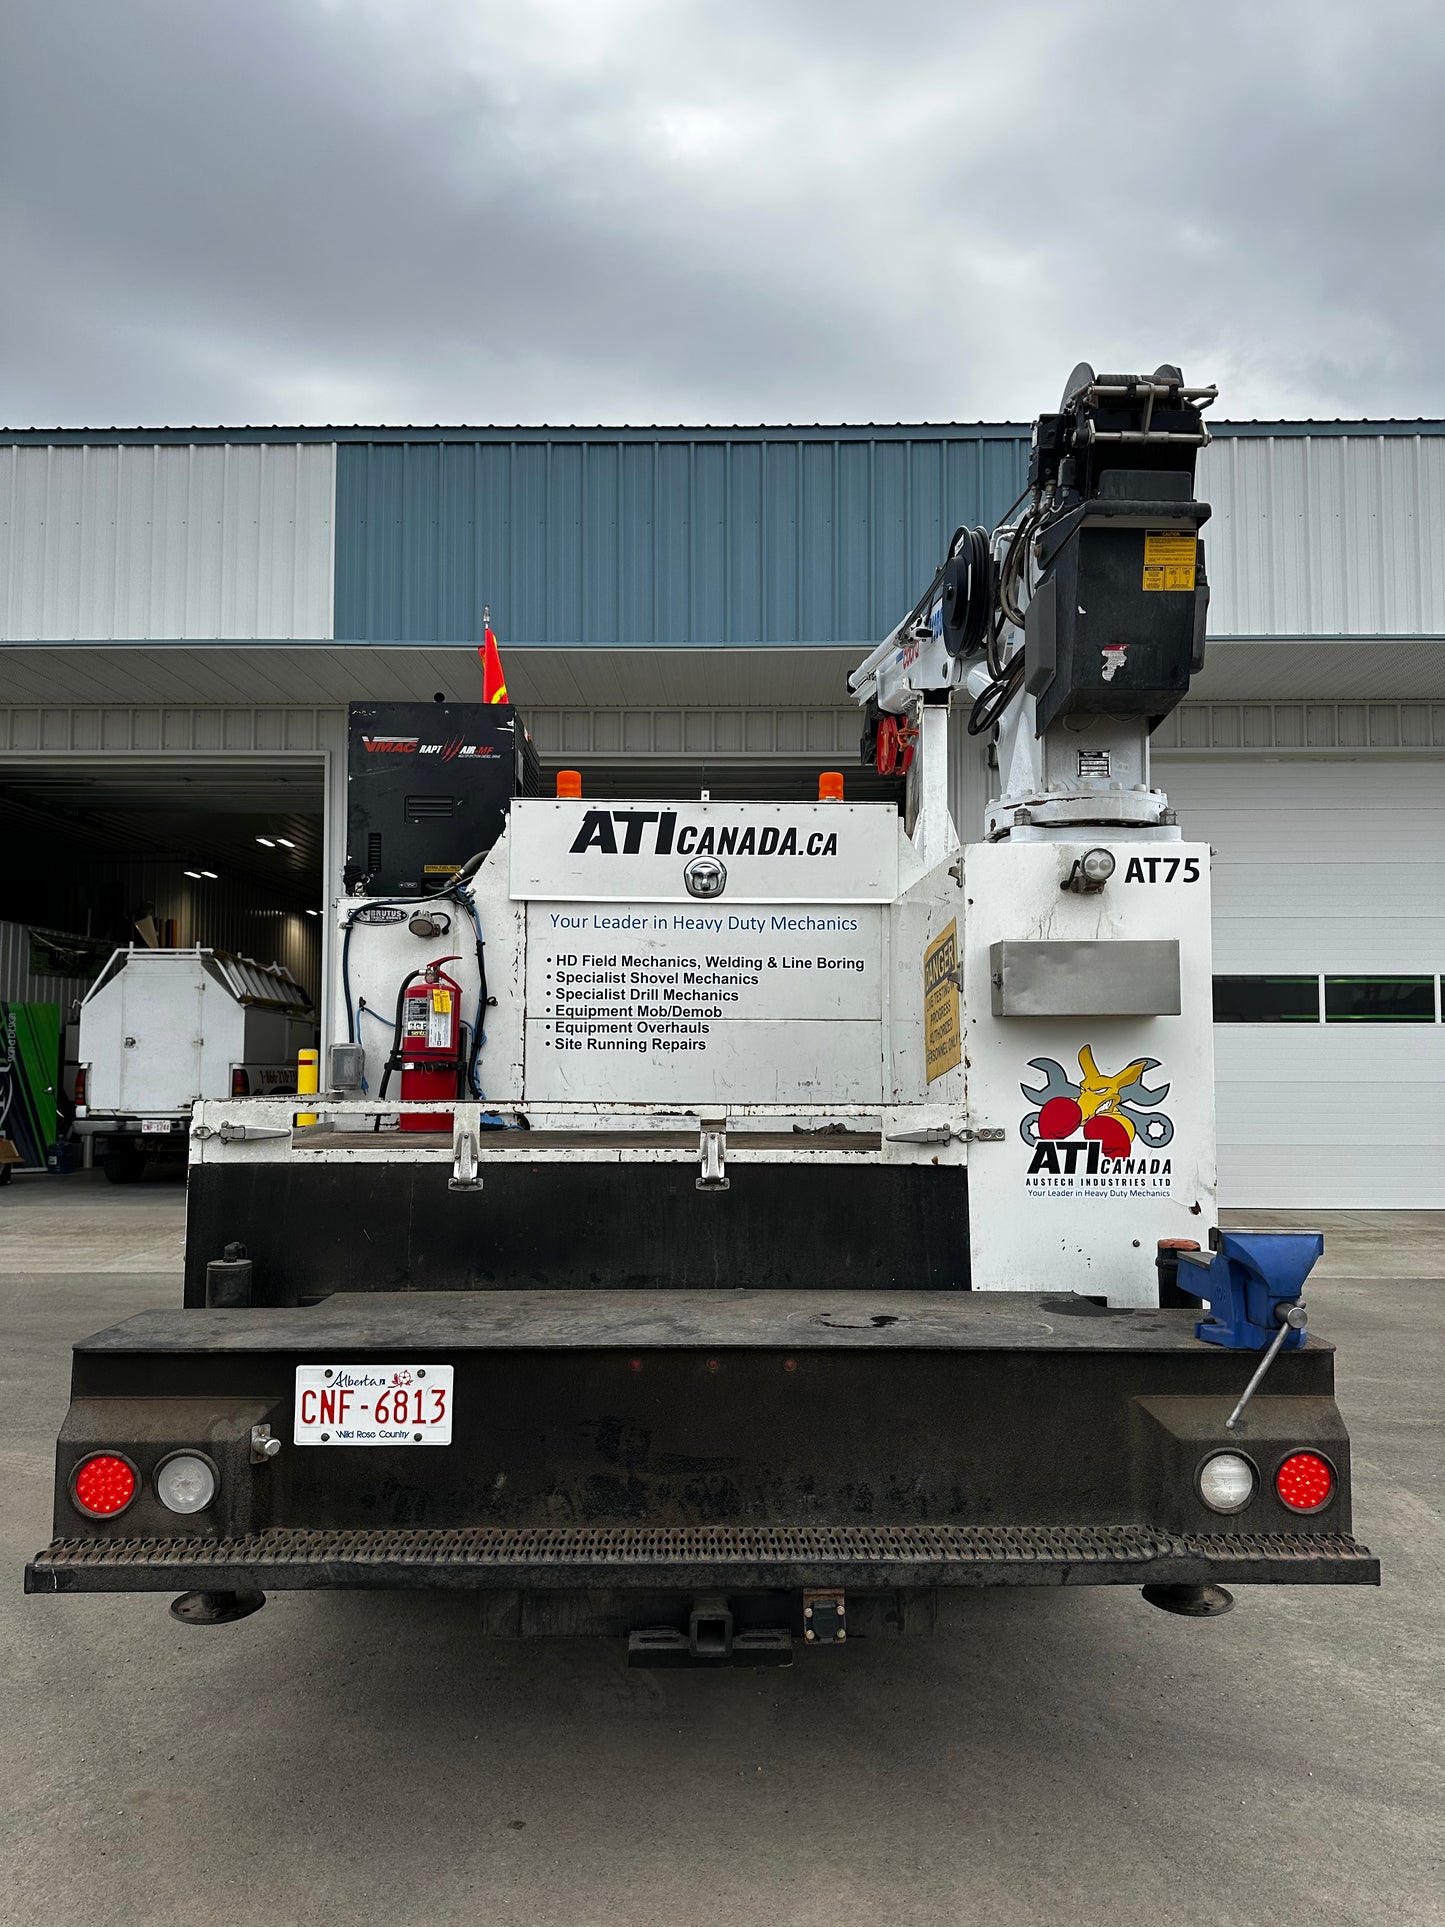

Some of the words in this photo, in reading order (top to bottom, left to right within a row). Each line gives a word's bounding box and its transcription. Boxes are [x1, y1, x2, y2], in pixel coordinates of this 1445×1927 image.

[361, 736, 420, 753] VMAC
[1124, 857, 1200, 883] AT75
[371, 909, 402, 917] BRUTUS
[550, 914, 588, 928] Your
[594, 914, 649, 929] Leader
[653, 915, 668, 930] in
[673, 915, 723, 933] Heavy
[728, 916, 766, 933] Duty
[771, 916, 858, 931] Mechanics
[556, 954, 577, 966] HD
[582, 955, 617, 967] Field
[621, 955, 701, 969] Mechanics,
[705, 956, 763, 971] Welding
[767, 956, 778, 968] &
[782, 957, 812, 969] Line
[817, 957, 865, 971] Boring
[925, 939, 955, 990] DANGER
[555, 971, 626, 985] Specialist
[630, 972, 679, 985] Shovel
[683, 972, 759, 985] Mechanics
[555, 988, 626, 1002] Specialist
[630, 988, 659, 1001] Drill
[664, 989, 739, 1001] Mechanics
[555, 1005, 633, 1018] Equipment
[637, 1005, 722, 1018] Mob/Demob
[930, 1000, 951, 1025] PROGRESS
[555, 1022, 633, 1035] Equipment
[637, 1022, 710, 1033] Overhauls
[555, 1038, 582, 1050] Site
[587, 1038, 647, 1052] Running
[652, 1038, 706, 1052] Repairs
[1027, 1142, 1101, 1174] ATI
[1100, 1159, 1171, 1174] CANADA
[1026, 1178, 1074, 1186] AUSTECH
[1081, 1178, 1146, 1186] INDUSTRIES
[1153, 1178, 1171, 1186] LTD
[1028, 1189, 1046, 1197] Your
[1048, 1189, 1073, 1197] Leader
[1085, 1190, 1108, 1198] Heavy
[1110, 1190, 1128, 1198] Duty
[327, 1371, 379, 1388] Alberta
[302, 1389, 446, 1424] CNF-6813
[336, 1430, 354, 1438] Wild
[357, 1430, 376, 1438] Rose
[379, 1430, 410, 1439] Country
